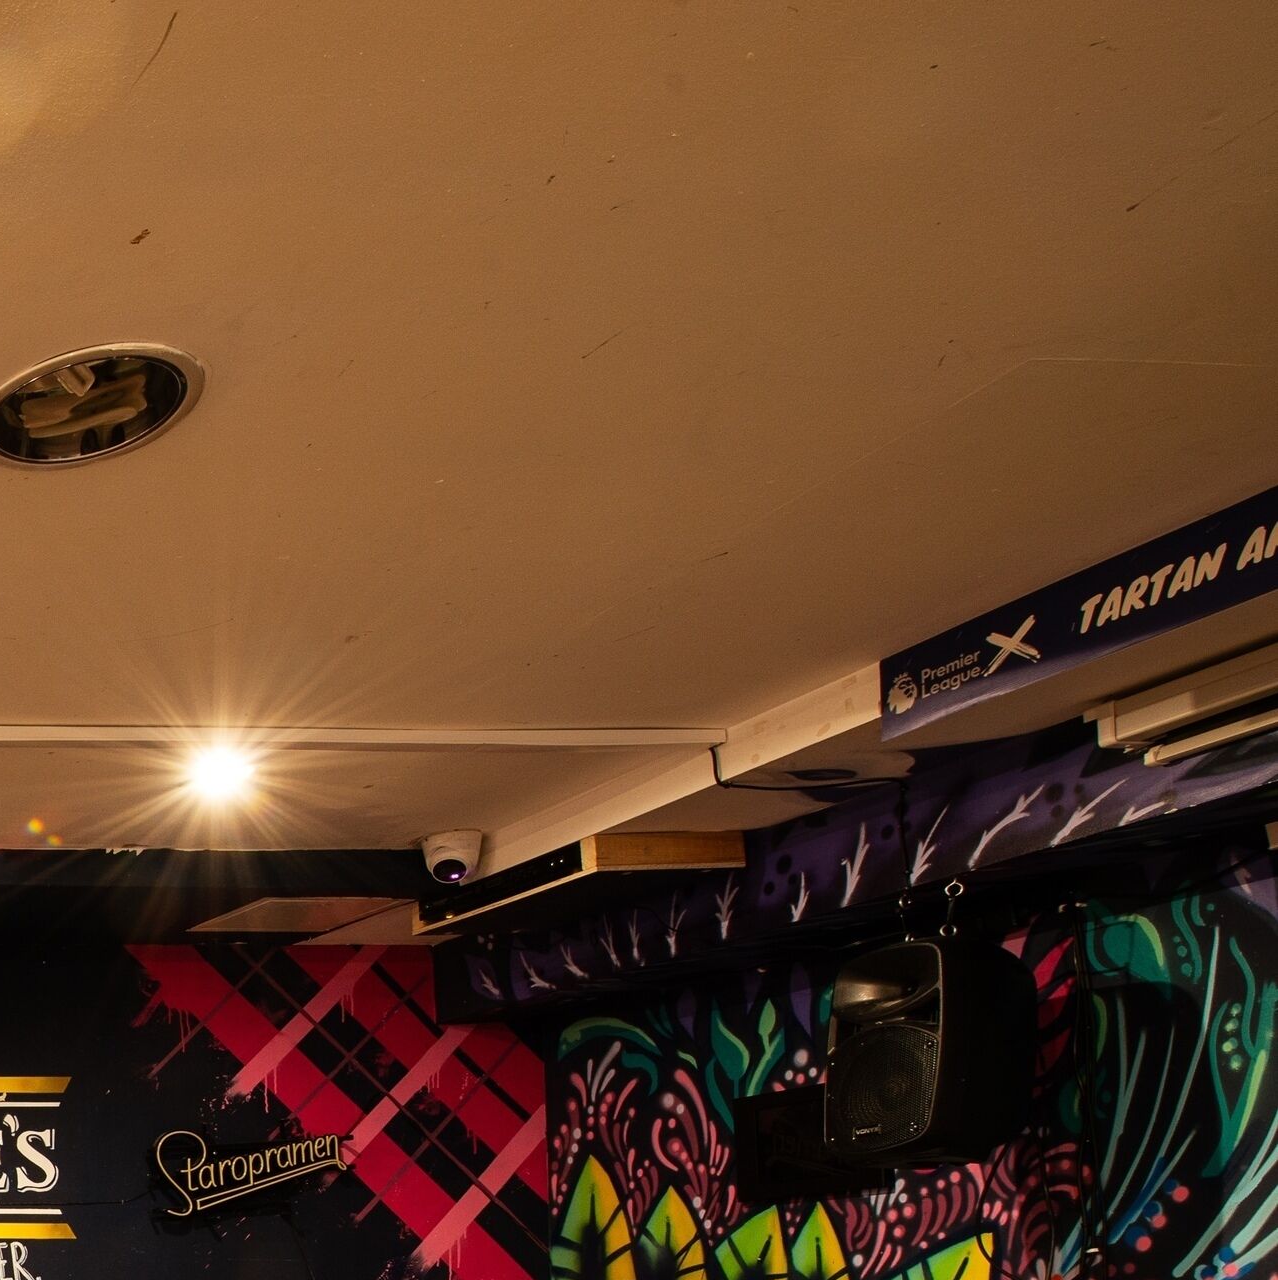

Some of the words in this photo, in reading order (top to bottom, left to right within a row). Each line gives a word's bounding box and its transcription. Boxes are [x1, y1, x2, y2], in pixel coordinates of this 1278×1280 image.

[1080, 542, 1227, 634] TARTAN
[1236, 521, 1278, 570] A
[921, 650, 981, 683] Premier
[921, 666, 981, 699] League
[156, 1130, 347, 1216] Staropramen
